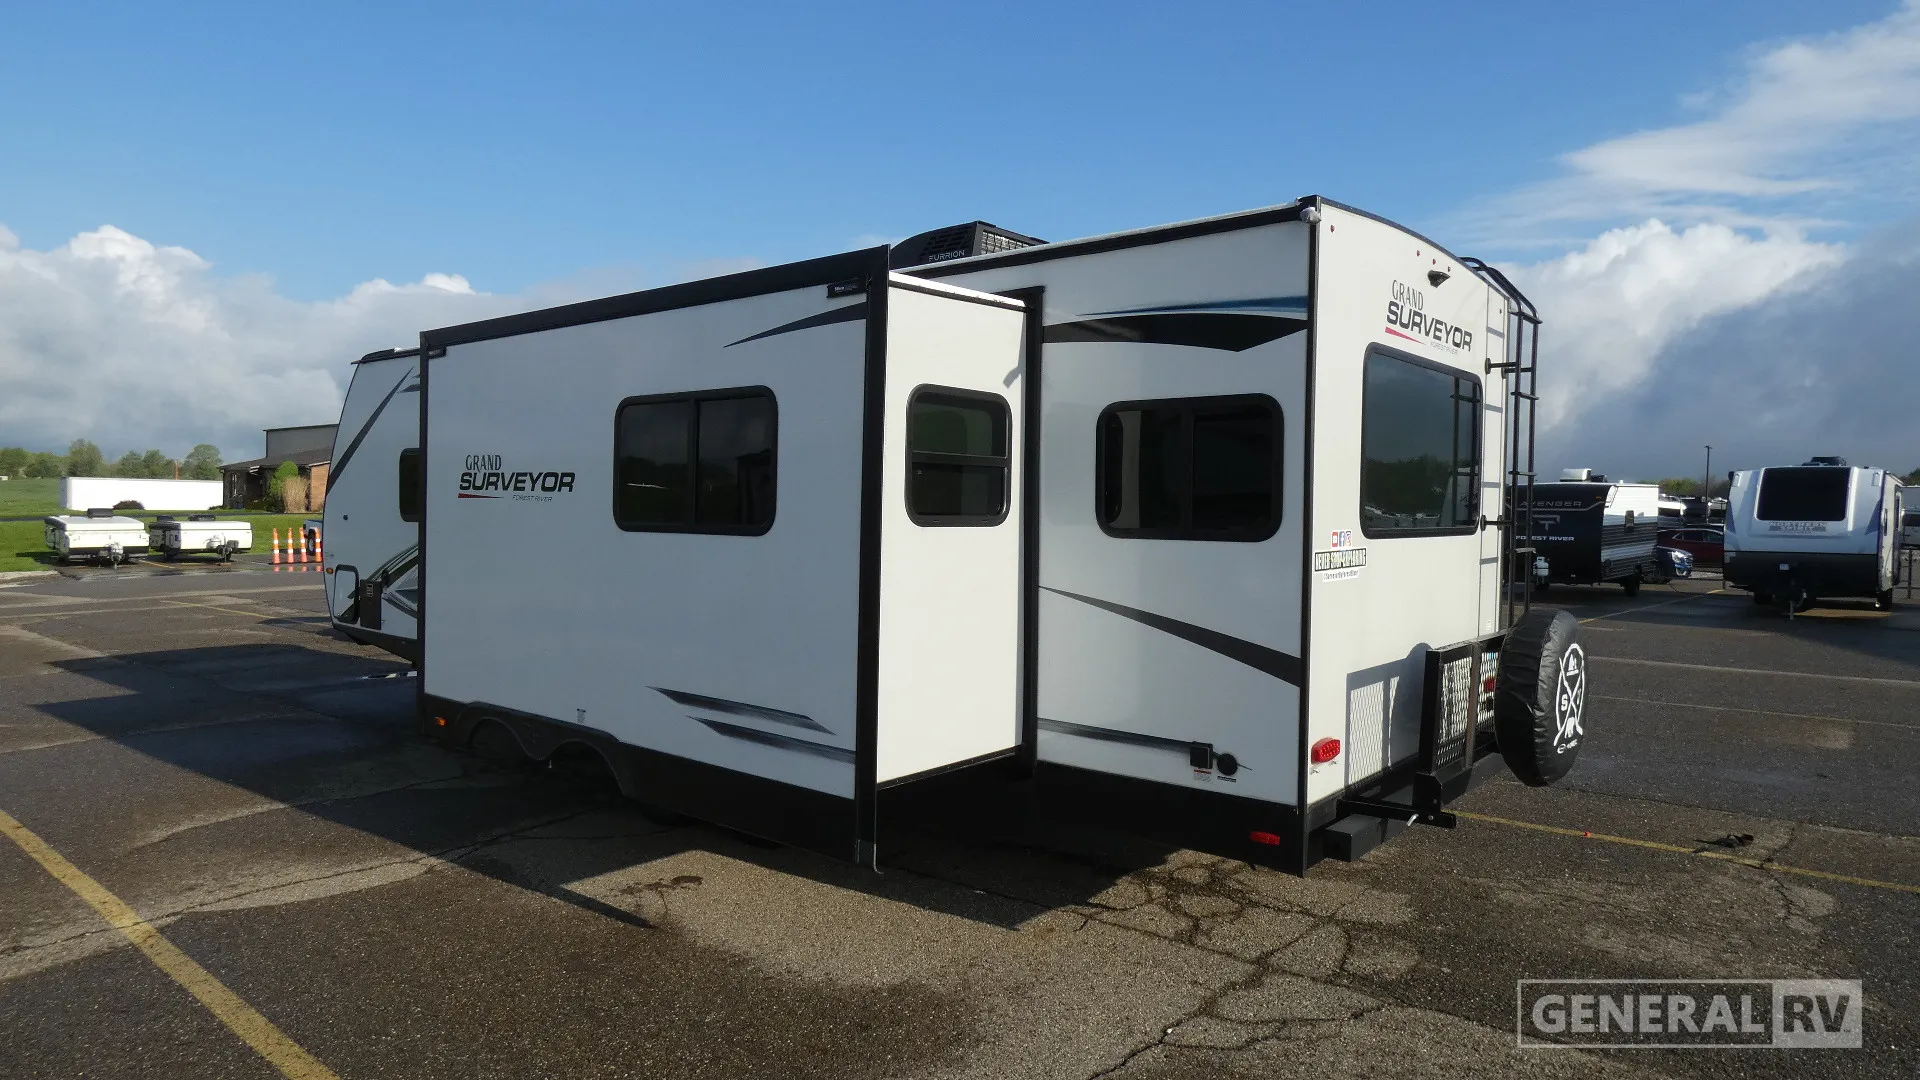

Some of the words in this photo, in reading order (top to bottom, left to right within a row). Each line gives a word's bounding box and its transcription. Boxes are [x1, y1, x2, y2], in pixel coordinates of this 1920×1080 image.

[928, 249, 965, 262] FURRION
[1391, 279, 1424, 311] GRAND
[1386, 300, 1473, 352] SURVEYOR
[465, 454, 502, 472] GRAND
[459, 471, 576, 492] SURVEYOR
[534, 495, 553, 503] RIVER
